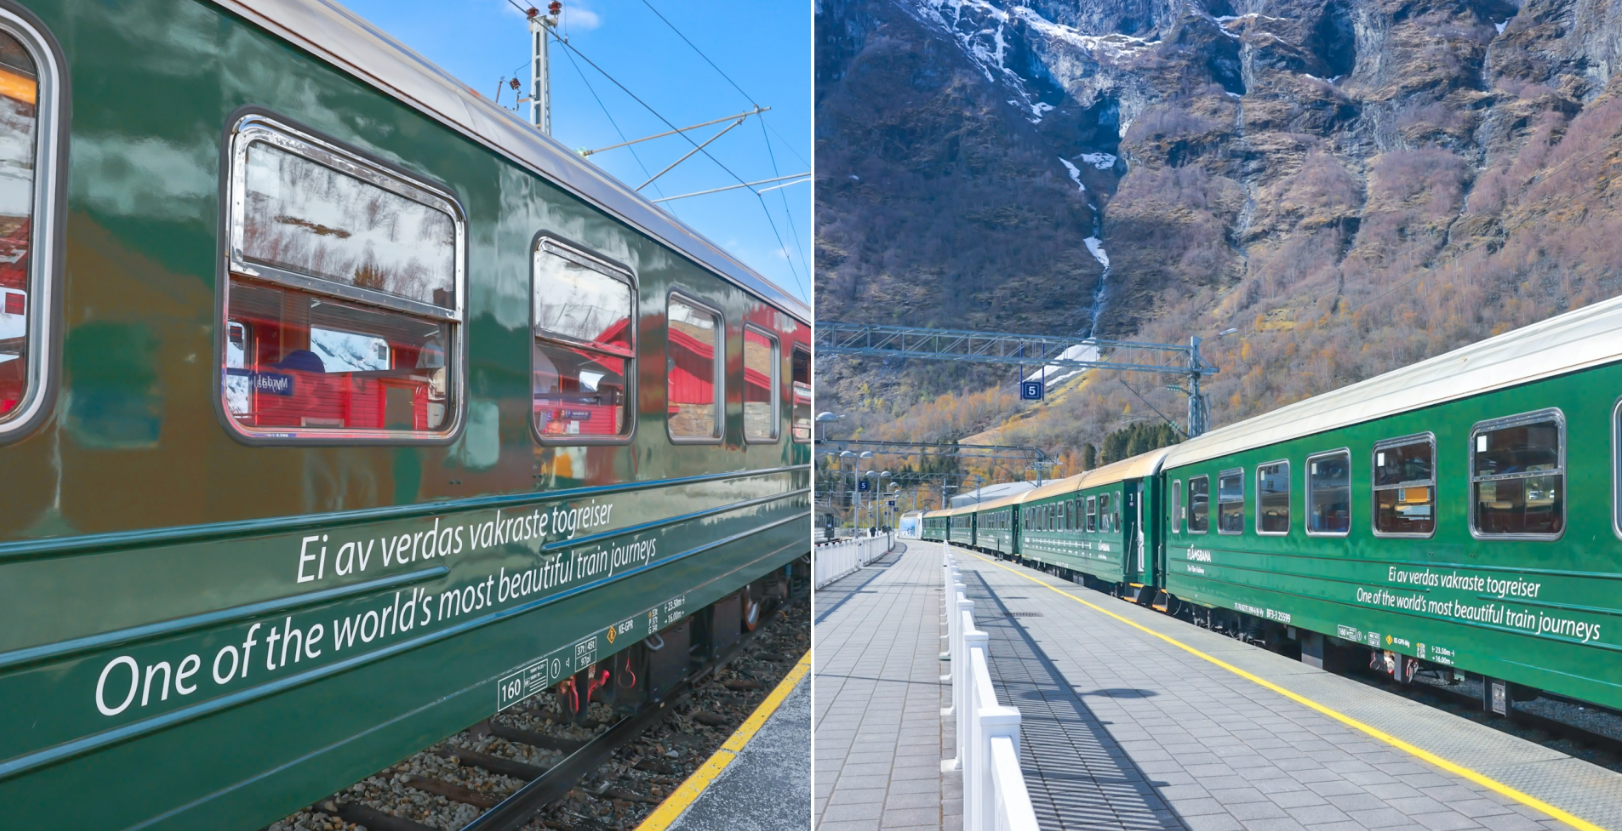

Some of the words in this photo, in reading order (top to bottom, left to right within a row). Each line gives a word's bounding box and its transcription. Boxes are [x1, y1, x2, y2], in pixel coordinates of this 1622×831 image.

[1028, 386, 1036, 396] 5
[296, 533, 328, 584] Ei
[335, 538, 374, 577] av
[381, 517, 464, 567] verdas
[469, 509, 549, 550] vakraste
[551, 499, 613, 541] togreiser
[1388, 566, 1397, 582] Ei
[1397, 570, 1408, 584] av
[1409, 568, 1439, 587] verdas
[1440, 571, 1484, 592] vakraste
[1486, 576, 1541, 599] togreiser
[95, 653, 201, 716] One
[212, 622, 261, 685] of
[265, 616, 324, 671] the
[333, 586, 432, 651] world's
[437, 574, 495, 622] most
[498, 547, 574, 602] beautiful
[576, 544, 608, 580] train
[608, 536, 657, 577] journeys
[1356, 587, 1372, 603] One
[1372, 589, 1382, 605] of
[1382, 590, 1396, 607] the
[1396, 594, 1426, 612] world's
[1428, 600, 1453, 616] most
[1454, 599, 1504, 624] beautiful
[1506, 608, 1536, 630] train
[1535, 611, 1601, 643] journeys
[501, 679, 521, 702] 160
